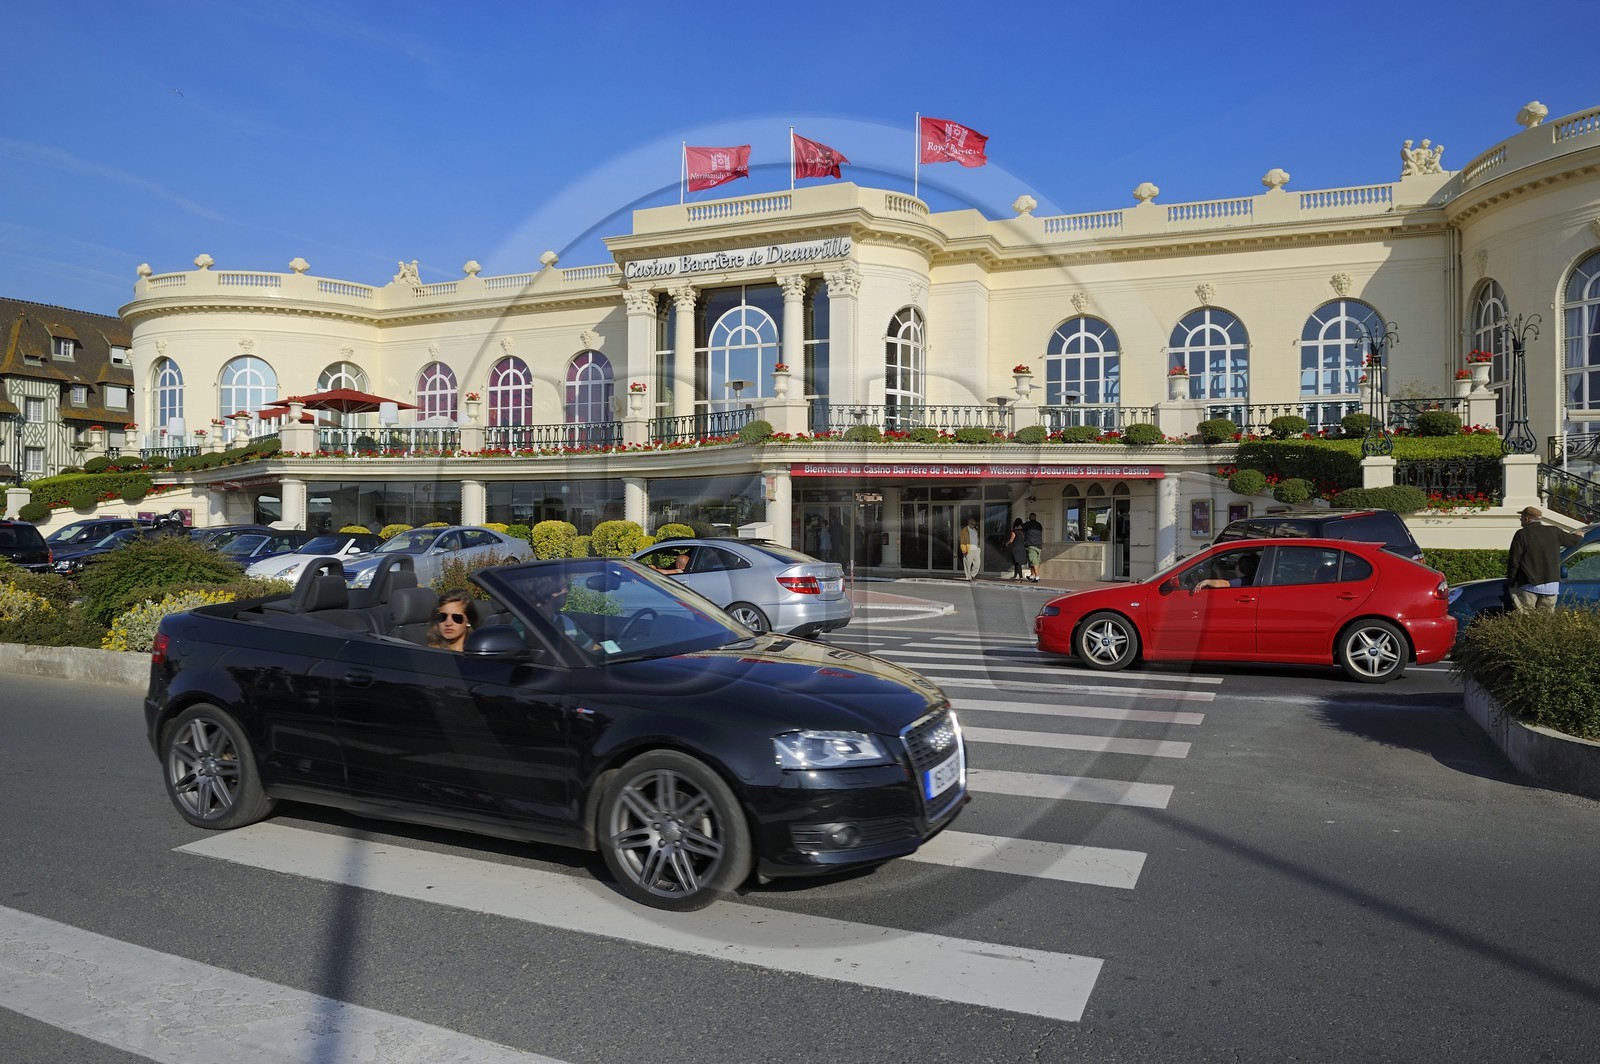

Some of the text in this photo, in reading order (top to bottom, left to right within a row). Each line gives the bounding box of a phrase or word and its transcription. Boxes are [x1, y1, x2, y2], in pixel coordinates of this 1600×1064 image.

[690, 172, 725, 181] Normandy
[624, 237, 851, 280] Casino Barrière de Deauville
[804, 464, 848, 474] Bienvenue
[850, 466, 861, 474] au
[863, 465, 891, 474] Casino
[893, 465, 927, 475] Barrière
[930, 466, 941, 475] de
[943, 465, 981, 475] Deauville
[989, 466, 1027, 475] Welcome
[1029, 466, 1039, 475] to
[1041, 466, 1084, 475] Deauville's
[1086, 466, 1120, 475] Barrière
[1122, 466, 1150, 475] Casino
